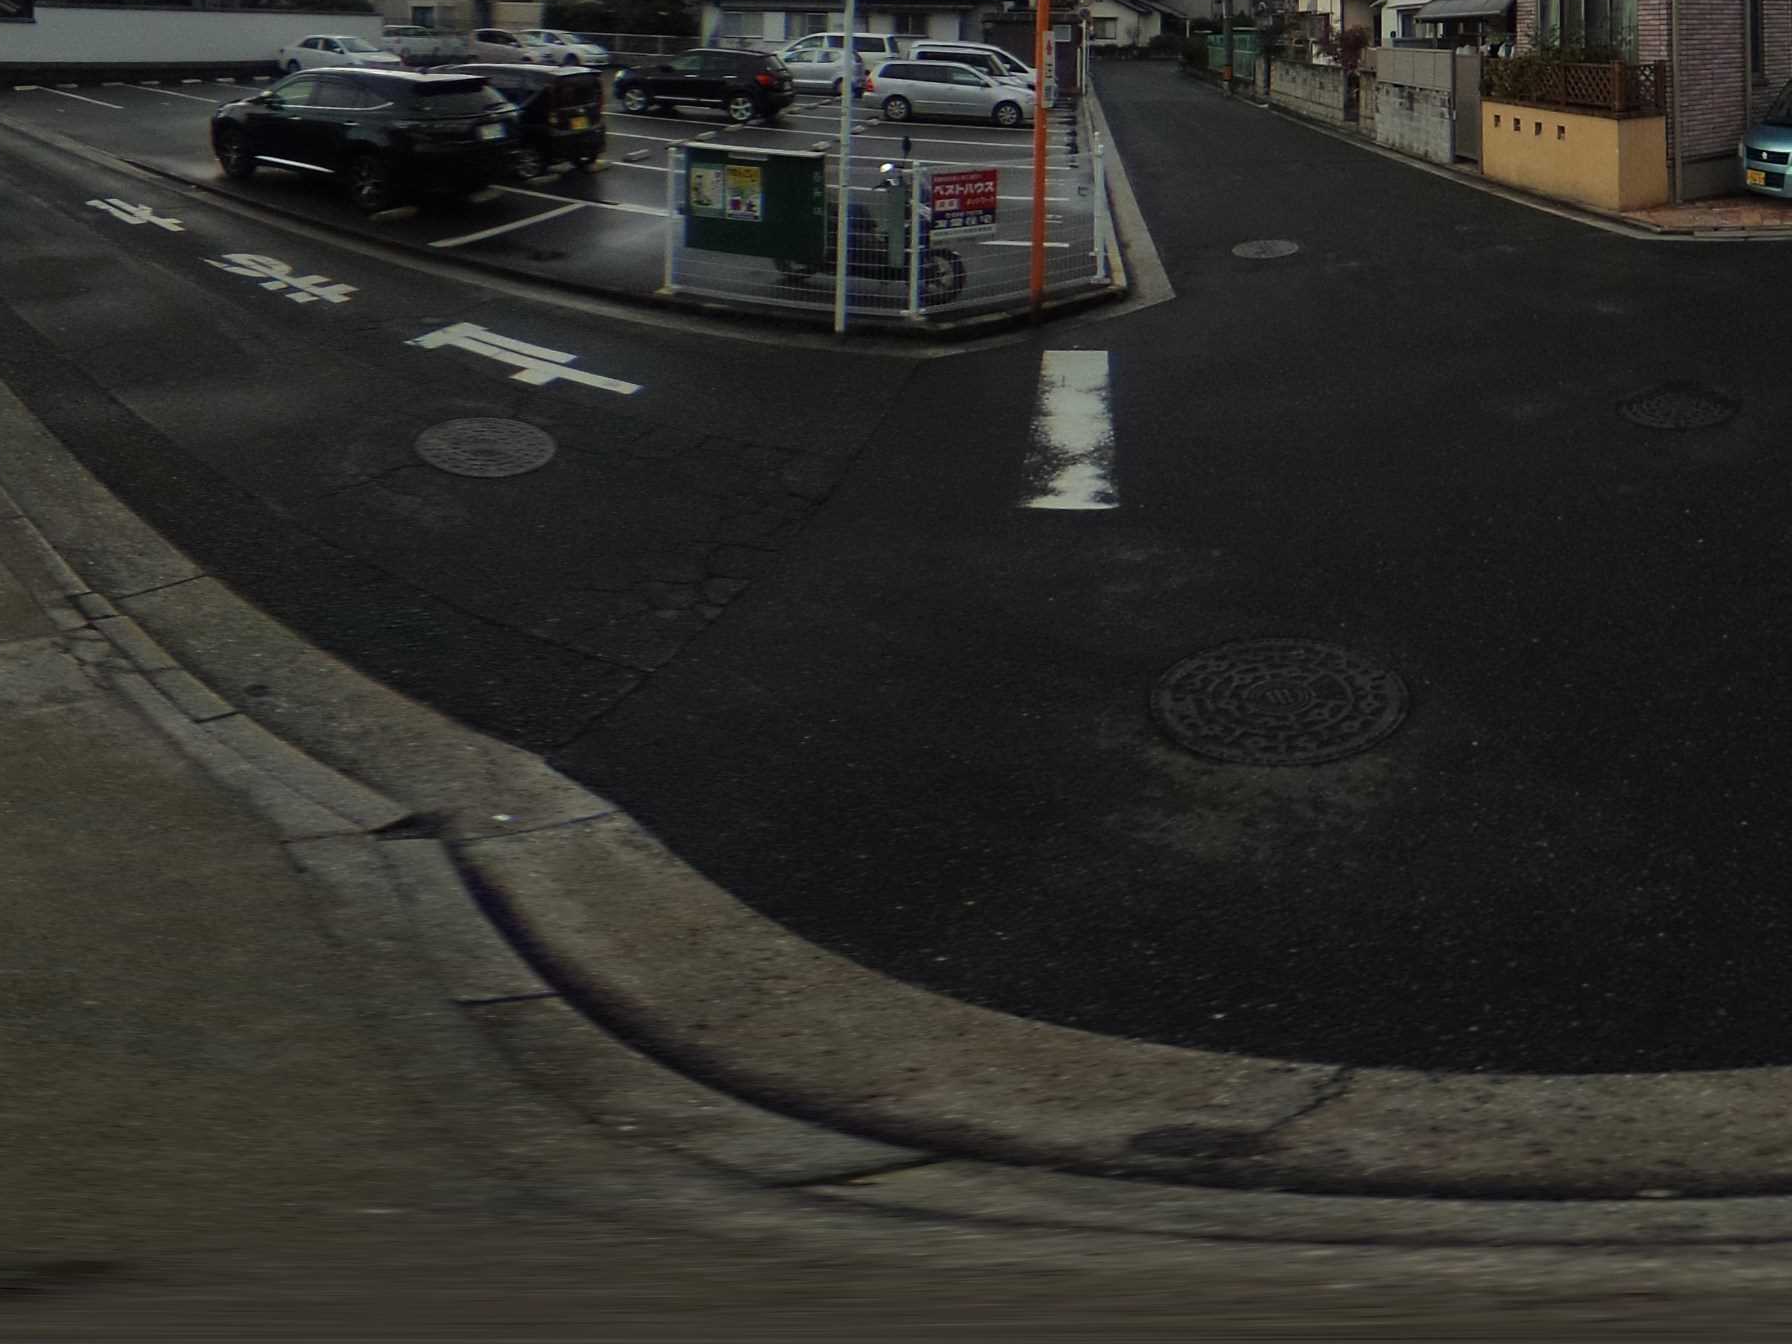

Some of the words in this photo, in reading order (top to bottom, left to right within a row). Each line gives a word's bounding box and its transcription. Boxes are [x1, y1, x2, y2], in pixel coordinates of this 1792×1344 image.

[934, 181, 994, 195] ベストハウス
[85, 197, 643, 394] 止まれ
